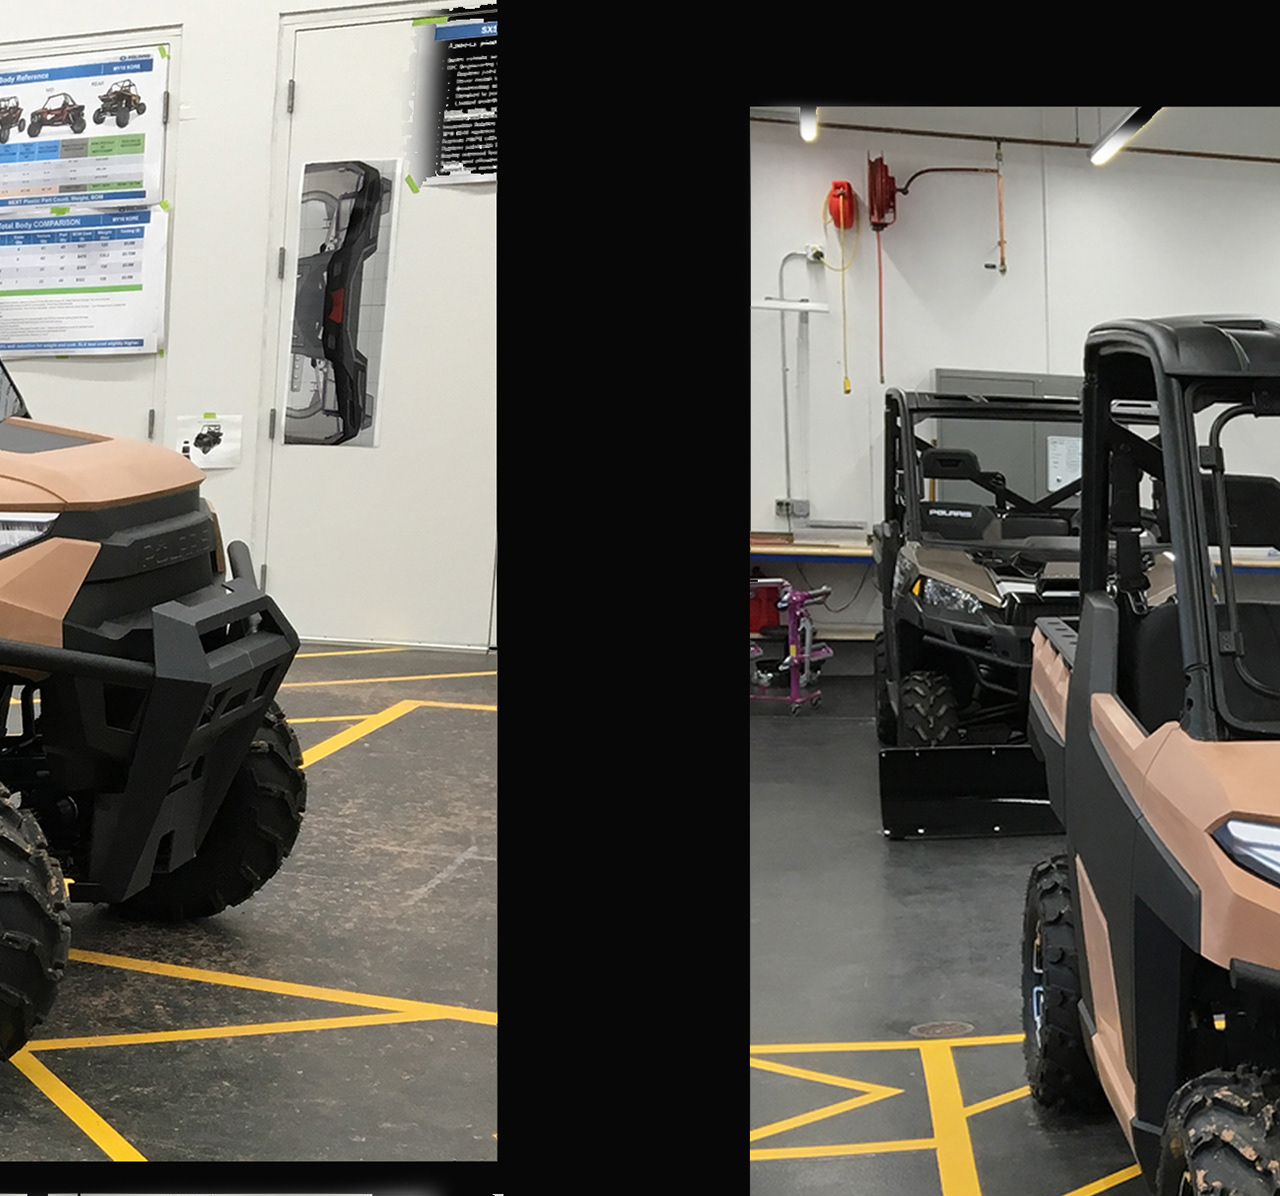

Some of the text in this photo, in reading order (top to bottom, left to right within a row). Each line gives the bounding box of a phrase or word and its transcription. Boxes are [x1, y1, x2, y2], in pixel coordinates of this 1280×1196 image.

[16, 73, 49, 81] Reference
[15, 221, 32, 229] Body
[33, 218, 81, 228] COMPARISON
[928, 508, 972, 518] POLARIS
